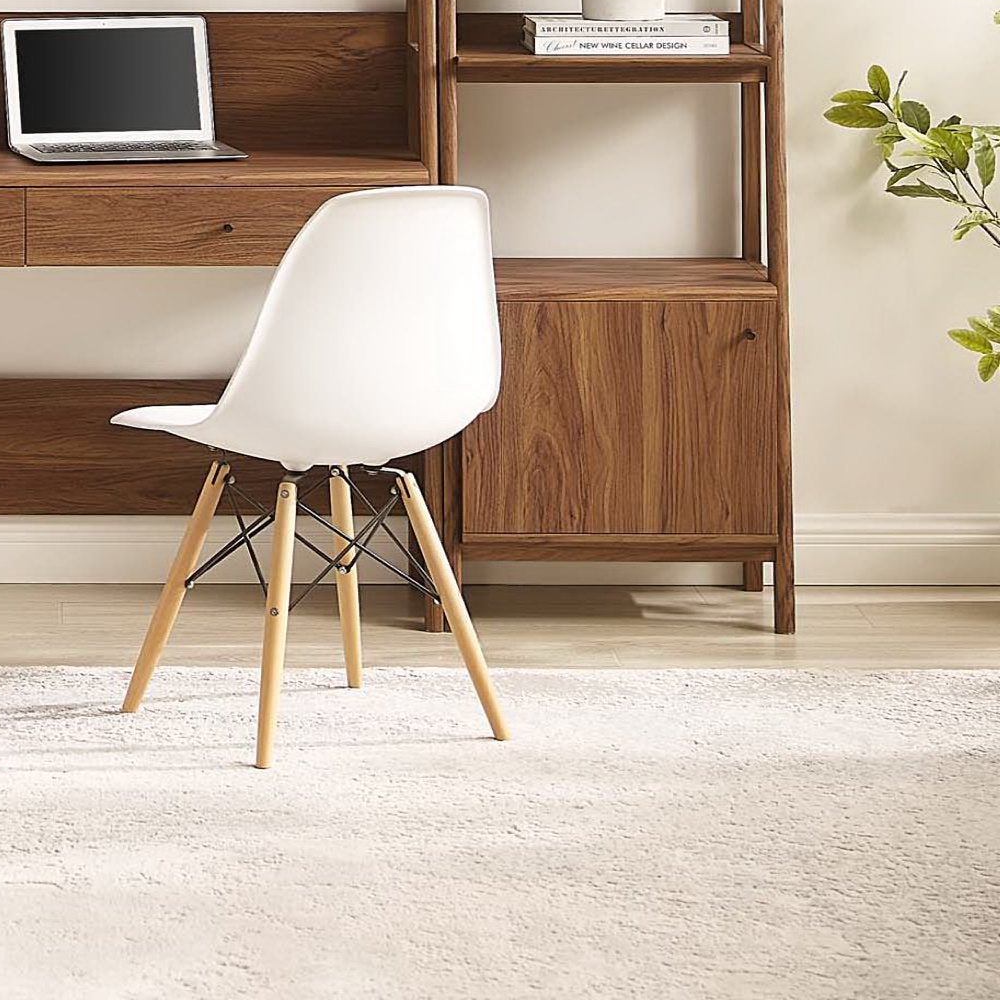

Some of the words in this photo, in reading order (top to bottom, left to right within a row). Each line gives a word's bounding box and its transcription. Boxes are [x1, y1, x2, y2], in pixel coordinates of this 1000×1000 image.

[579, 42, 598, 50] NEW
[601, 42, 622, 50] WINE
[624, 42, 654, 50] CELLAR
[656, 42, 688, 50] DESIGN
